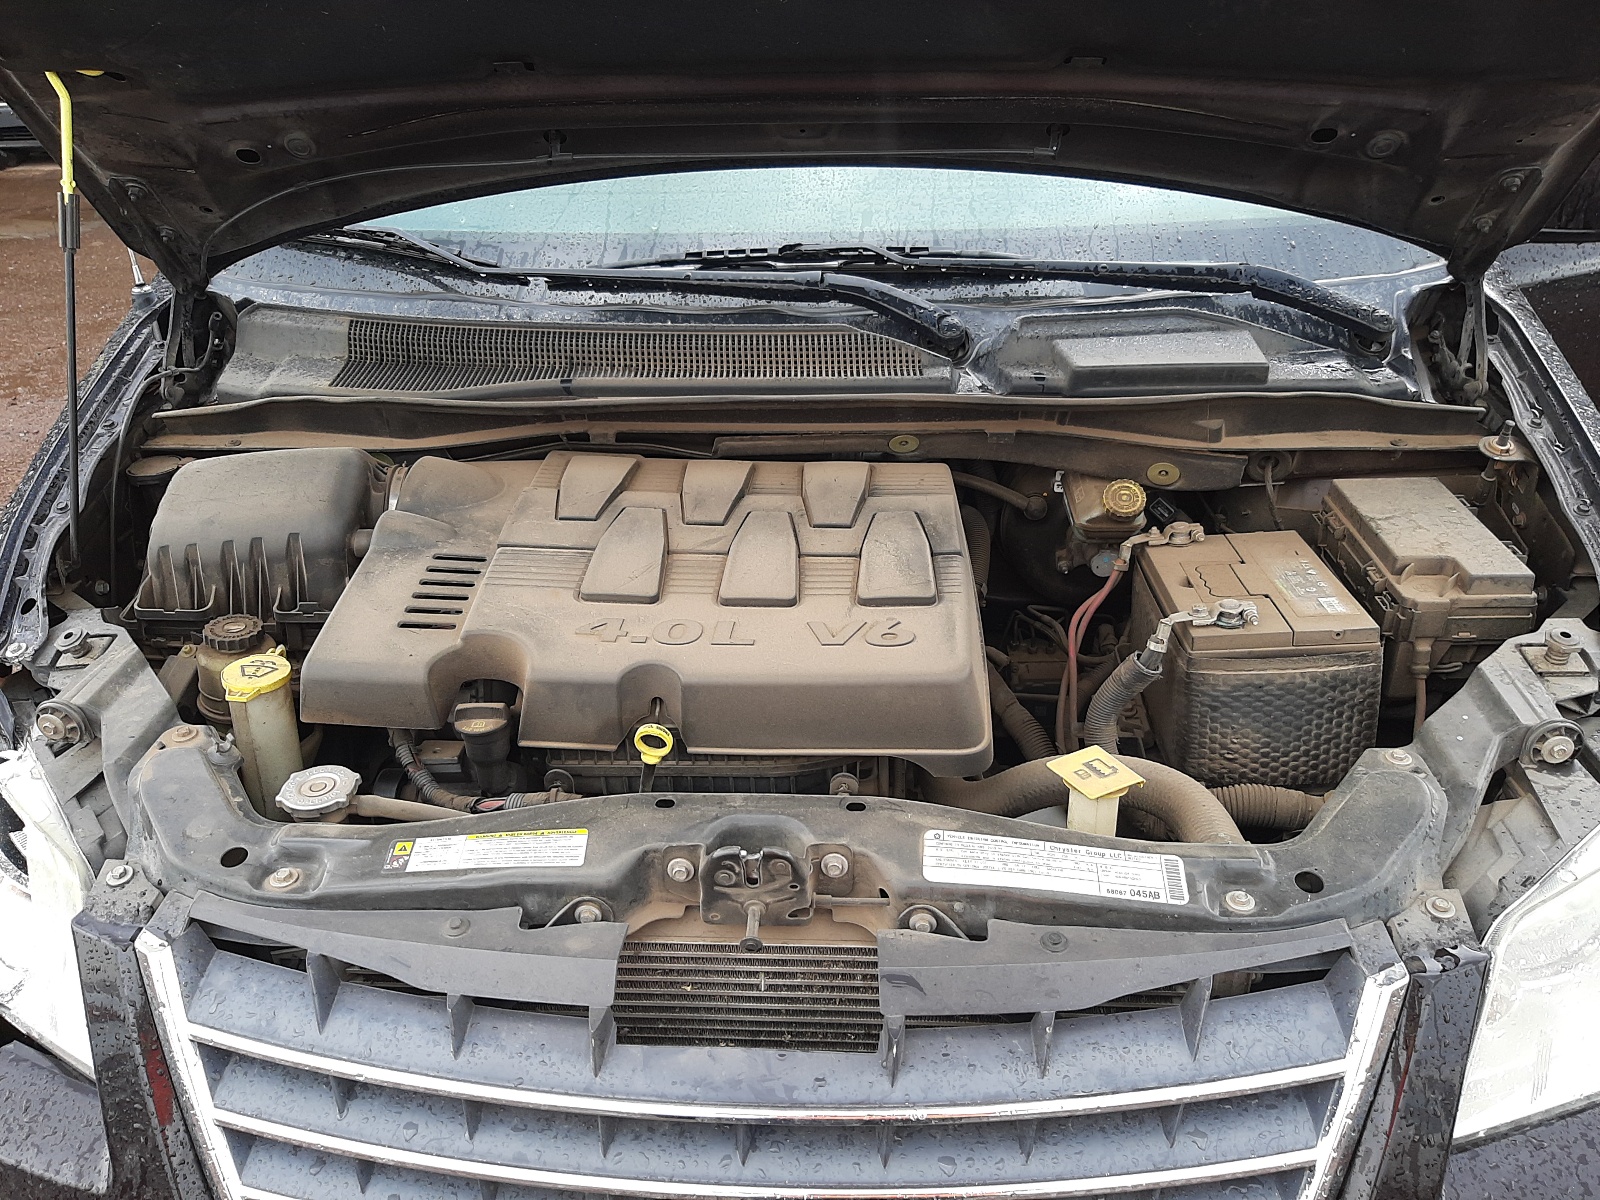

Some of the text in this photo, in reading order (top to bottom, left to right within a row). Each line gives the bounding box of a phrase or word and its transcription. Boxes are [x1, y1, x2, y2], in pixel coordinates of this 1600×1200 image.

[575, 617, 916, 647] 4.0L V6
[1049, 845, 1081, 854] Chrysler
[1085, 849, 1106, 858] Group
[1129, 888, 1161, 900] 045AB
